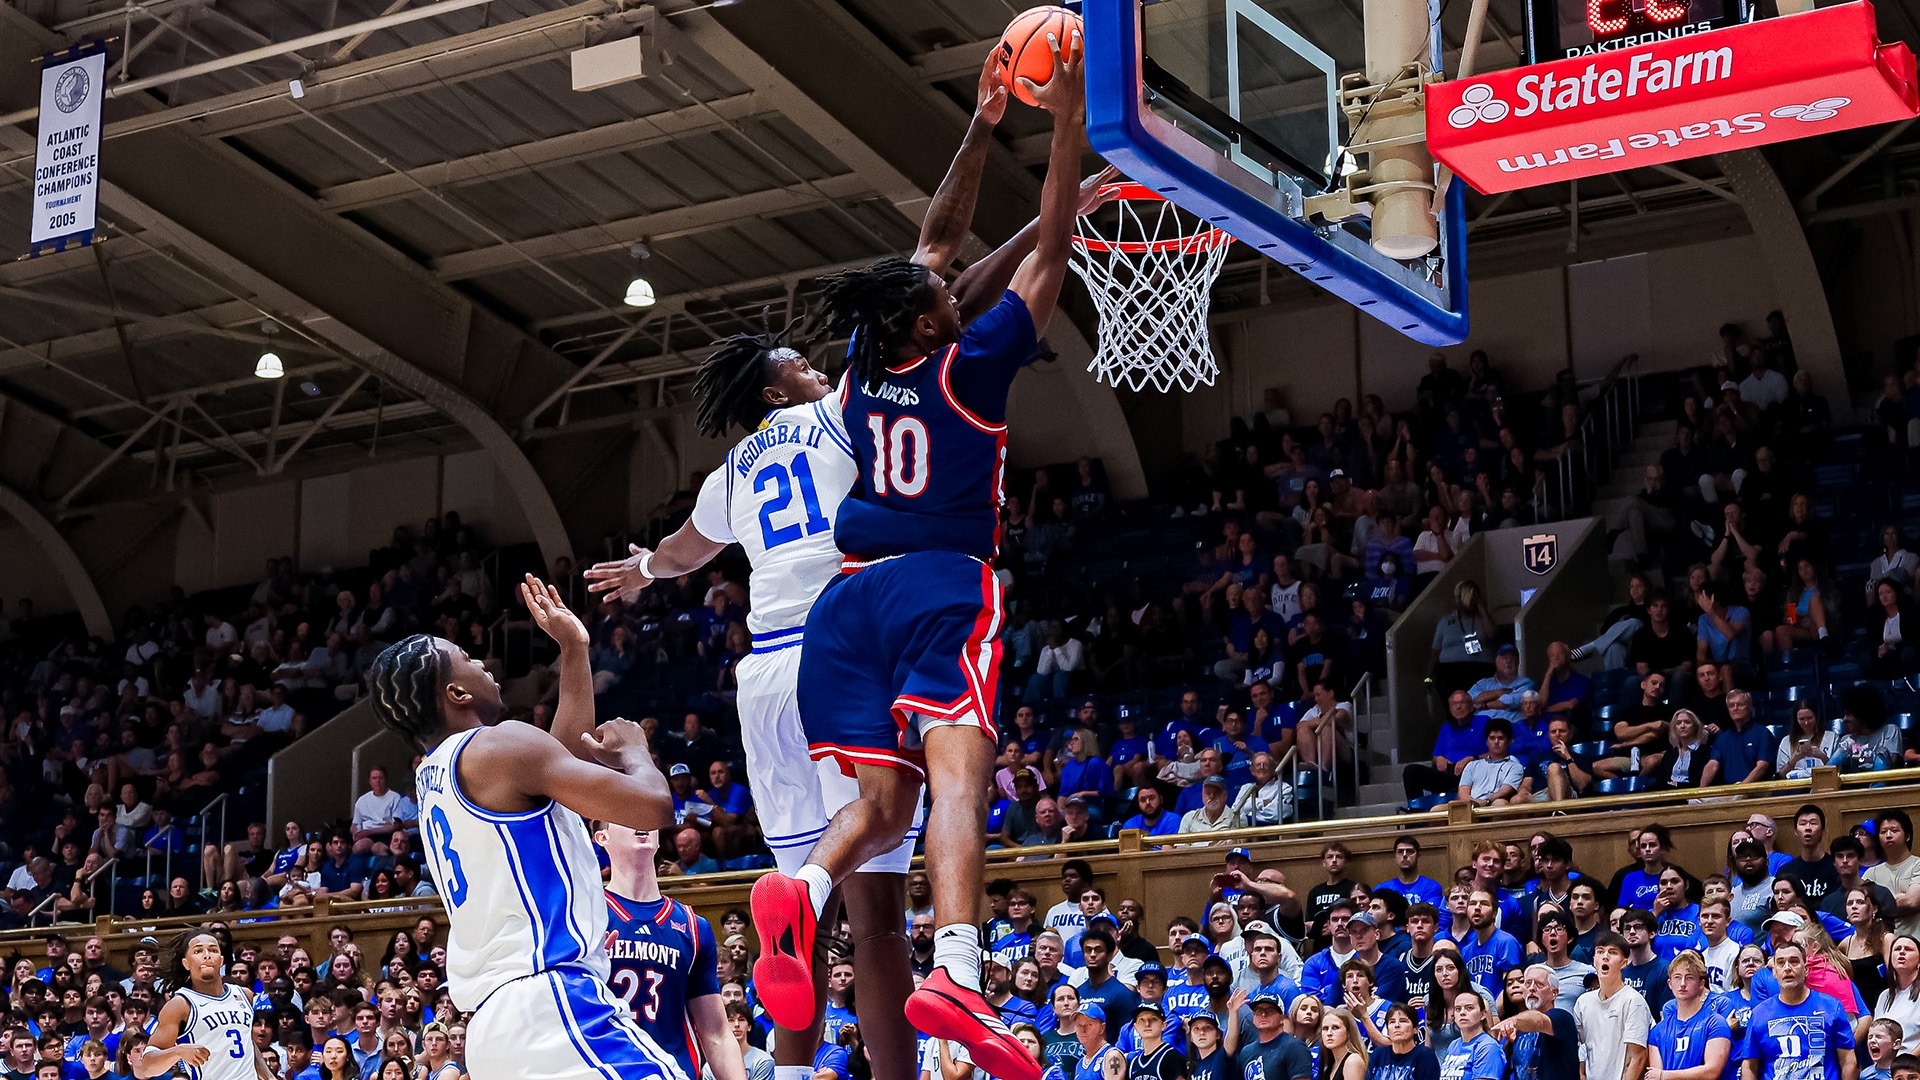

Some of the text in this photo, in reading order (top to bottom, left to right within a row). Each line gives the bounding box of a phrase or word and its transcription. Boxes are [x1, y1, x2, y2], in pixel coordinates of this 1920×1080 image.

[1566, 22, 1711, 58] DAKTRONICS
[47, 124, 90, 147] ATLANTIC
[53, 142, 83, 161] COAST
[36, 154, 96, 181] CONFERENCE
[37, 172, 92, 197] CHAMPIONS
[45, 194, 82, 209] TOURNAMENT
[49, 211, 76, 229] 2005
[736, 424, 824, 478] NGONGBA II
[867, 413, 930, 497] 10
[753, 451, 831, 551] 21
[1529, 544, 1552, 568] 14
[1273, 593, 1298, 606] DUKE
[1052, 913, 1085, 927] DUKE
[1658, 919, 1696, 937] UKE
[613, 968, 664, 1021] 23
[1168, 993, 1210, 1012] DUKE
[202, 1011, 251, 1031] DUKE
[226, 1029, 245, 1058] 3
[1675, 1037, 1689, 1052] D
[1777, 1035, 1801, 1057] D
